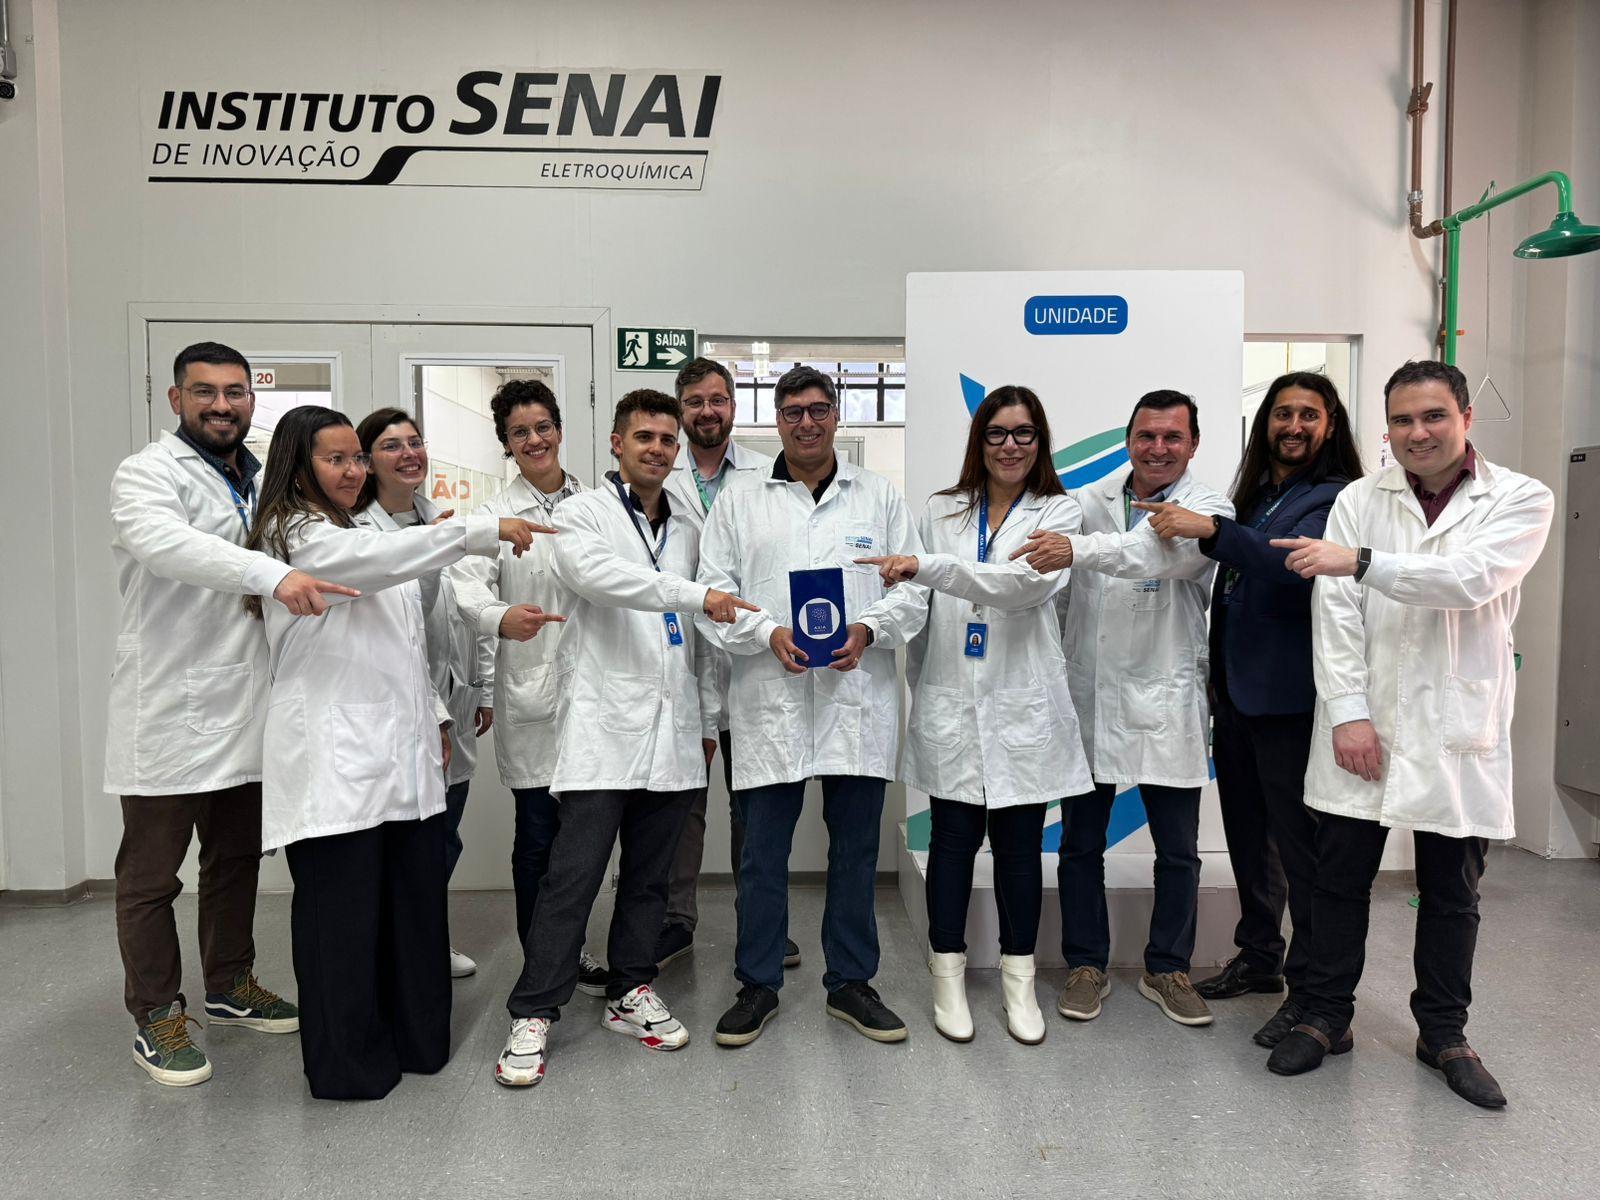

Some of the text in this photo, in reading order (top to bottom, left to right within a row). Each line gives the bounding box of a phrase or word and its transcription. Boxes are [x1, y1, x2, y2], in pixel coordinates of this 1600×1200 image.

[158, 70, 721, 137] INSTITUTO SENAI
[152, 140, 360, 172] DE INOVAÇÃO
[541, 162, 693, 179] ELETROQUÍMICA
[1034, 307, 1118, 324] UNIDADE
[655, 331, 687, 347] SAÍDA
[256, 372, 273, 384] 20
